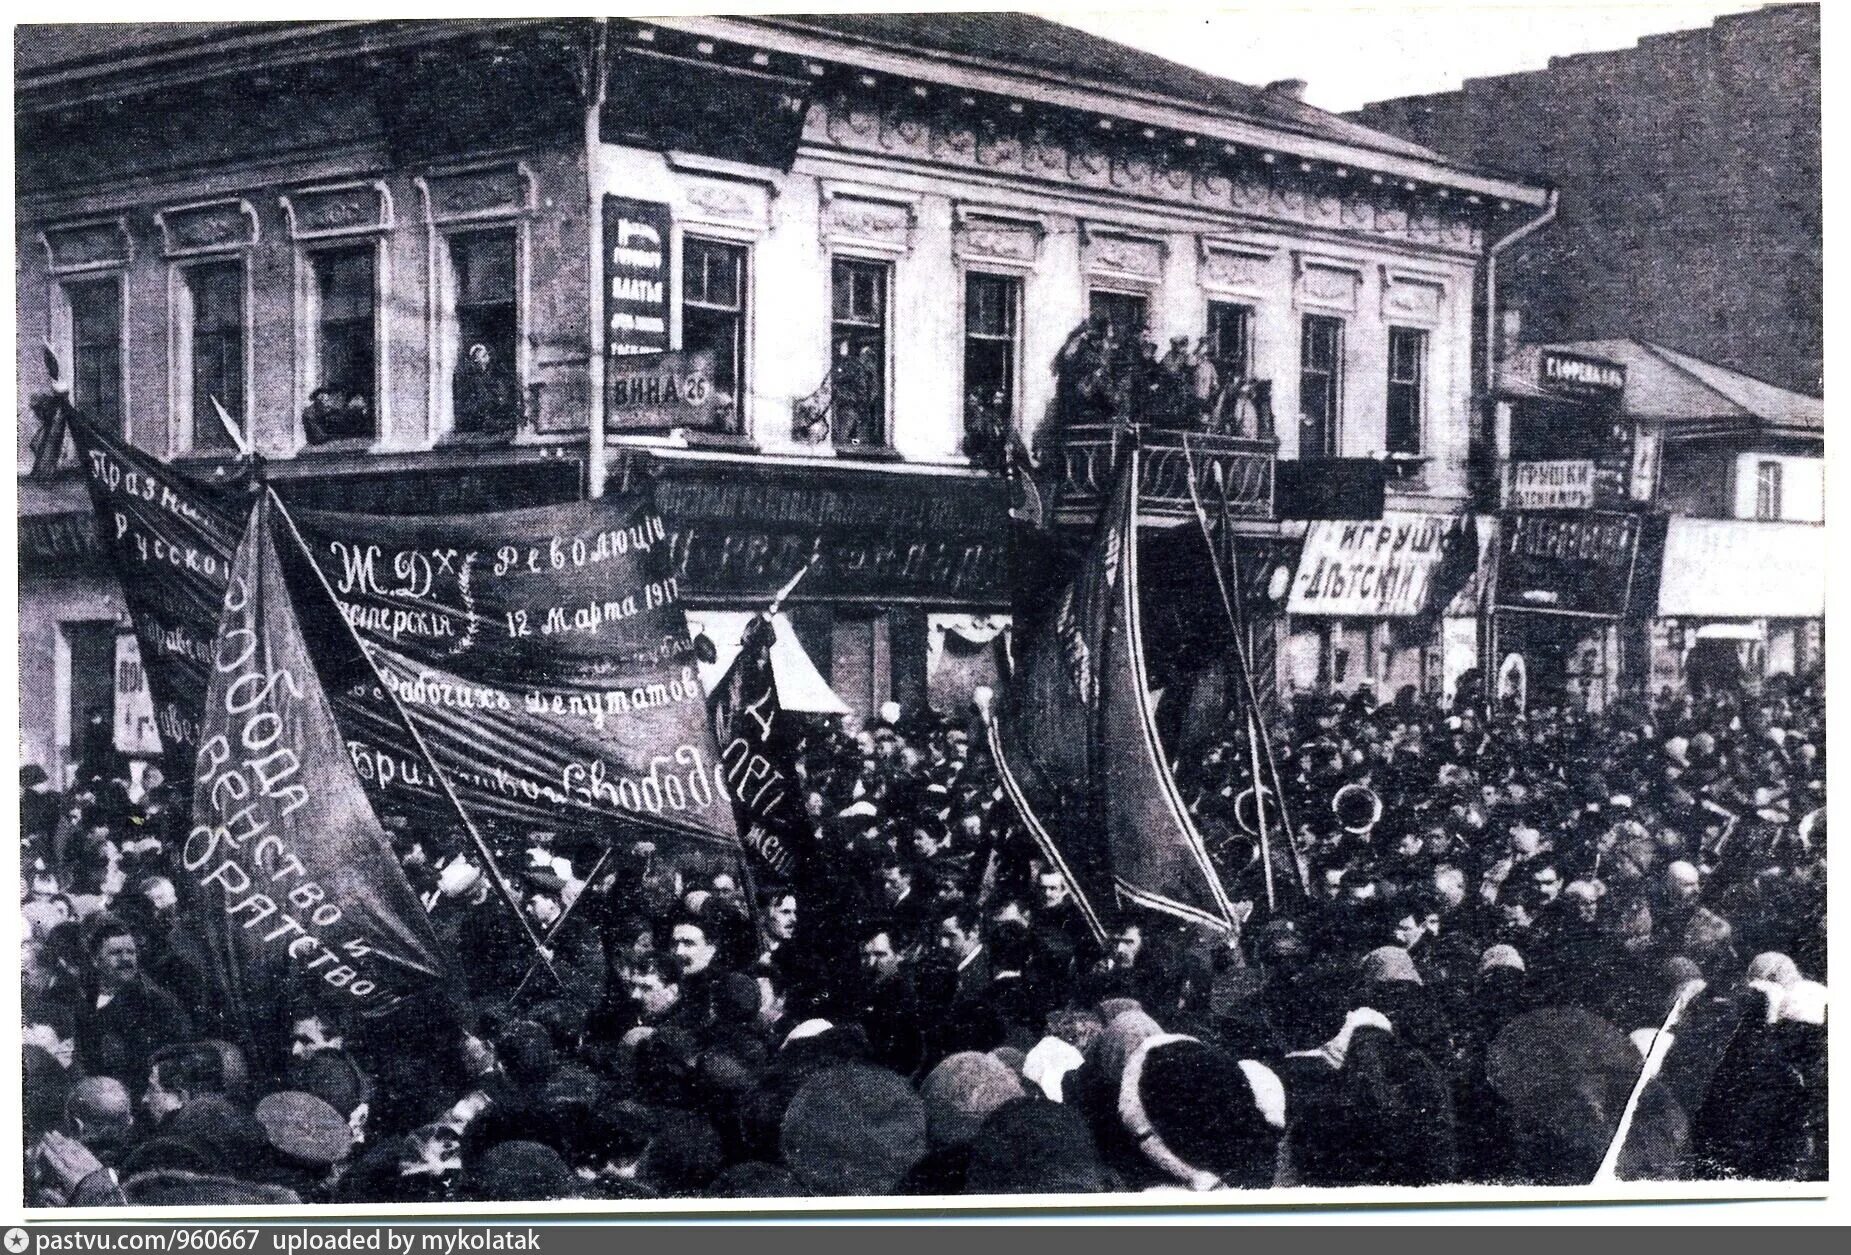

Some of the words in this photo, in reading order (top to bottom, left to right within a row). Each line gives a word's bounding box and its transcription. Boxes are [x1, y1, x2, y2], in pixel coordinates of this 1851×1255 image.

[506, 609, 532, 638] 12
[541, 601, 638, 635] Марта
[645, 576, 679, 610] 1917
